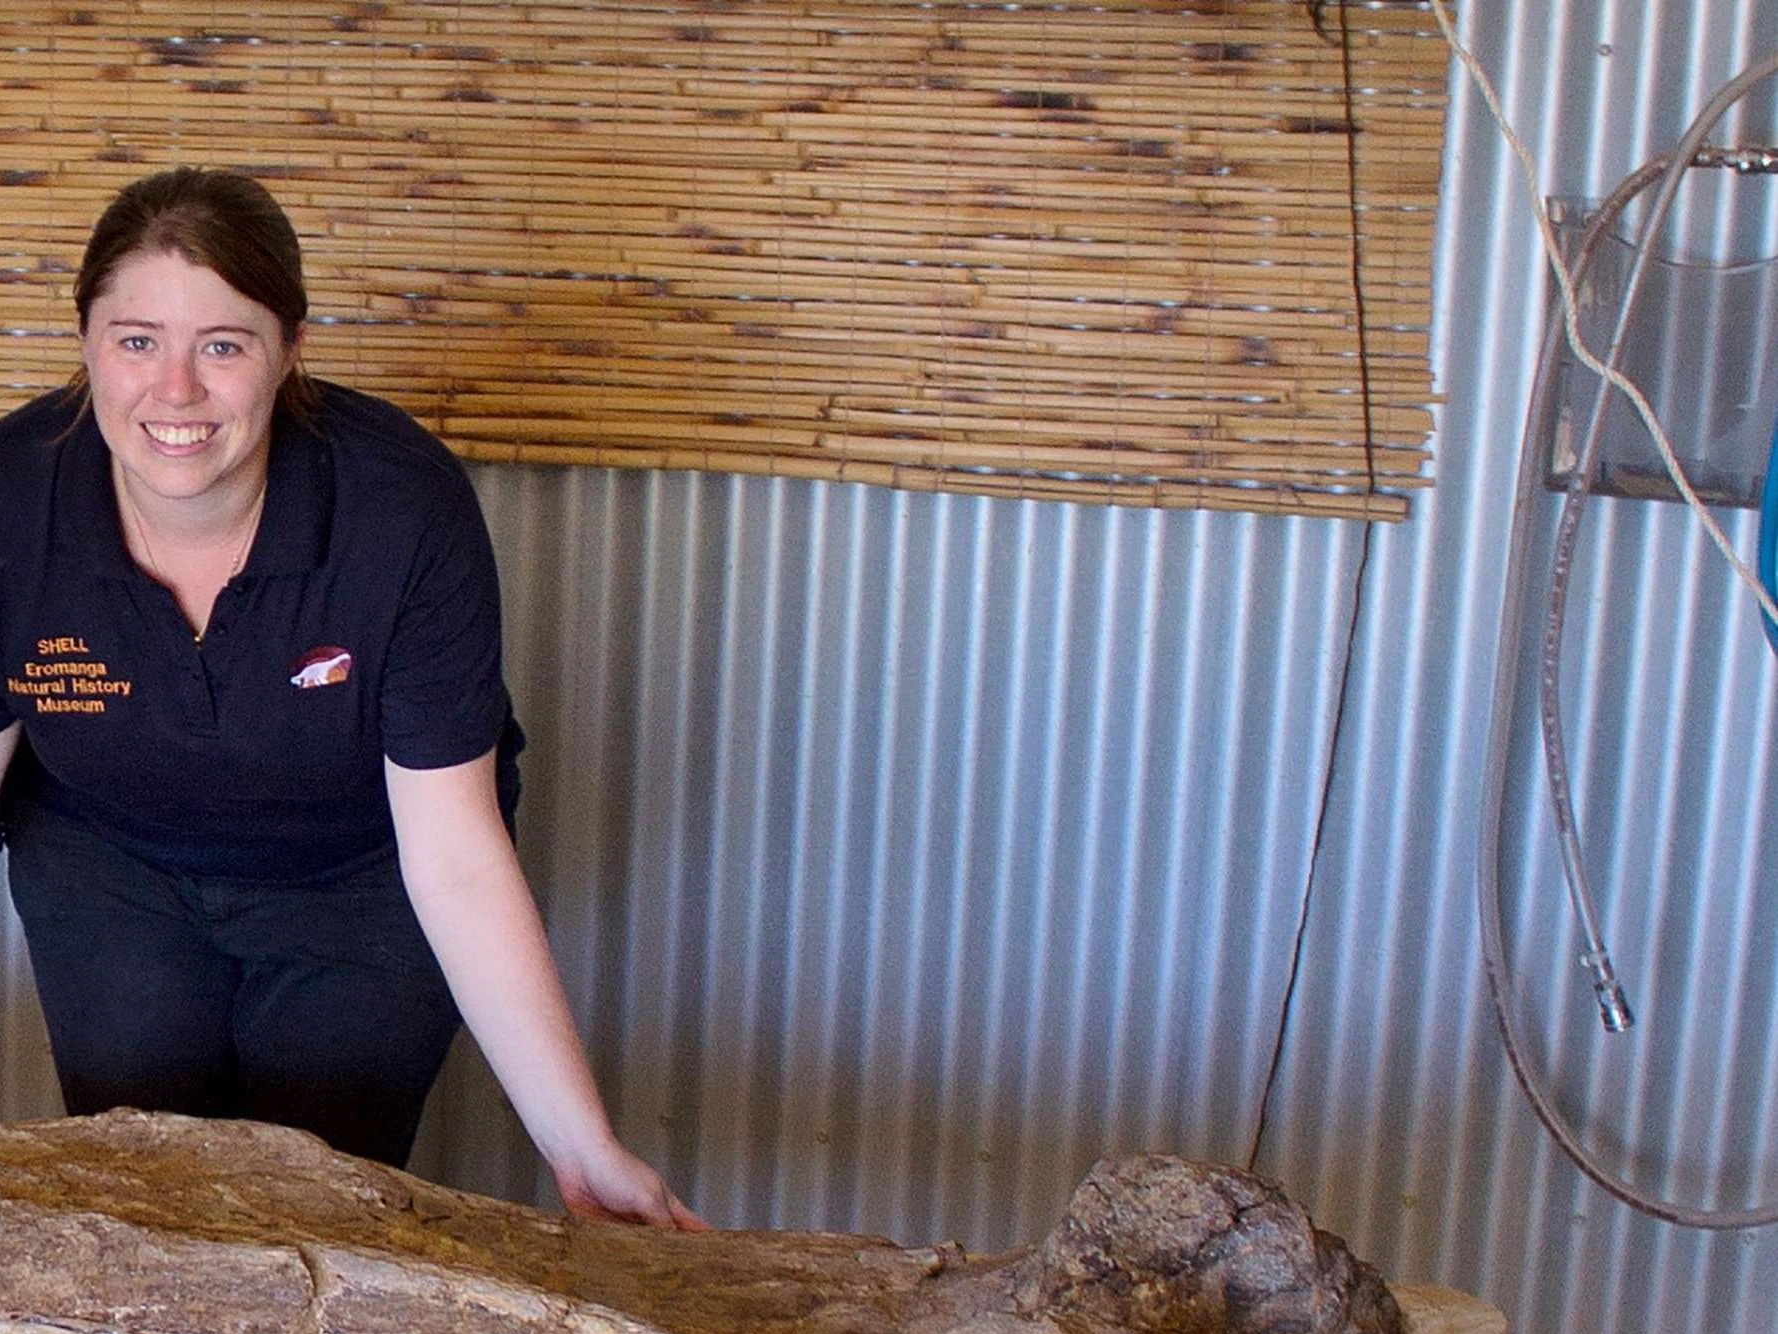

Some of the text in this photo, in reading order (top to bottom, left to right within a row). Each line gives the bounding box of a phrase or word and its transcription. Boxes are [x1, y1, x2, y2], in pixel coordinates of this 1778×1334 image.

[36, 637, 90, 655] SHELL
[25, 662, 107, 679] Eromanga
[8, 677, 131, 696] Natural History
[36, 697, 105, 713] Museum
